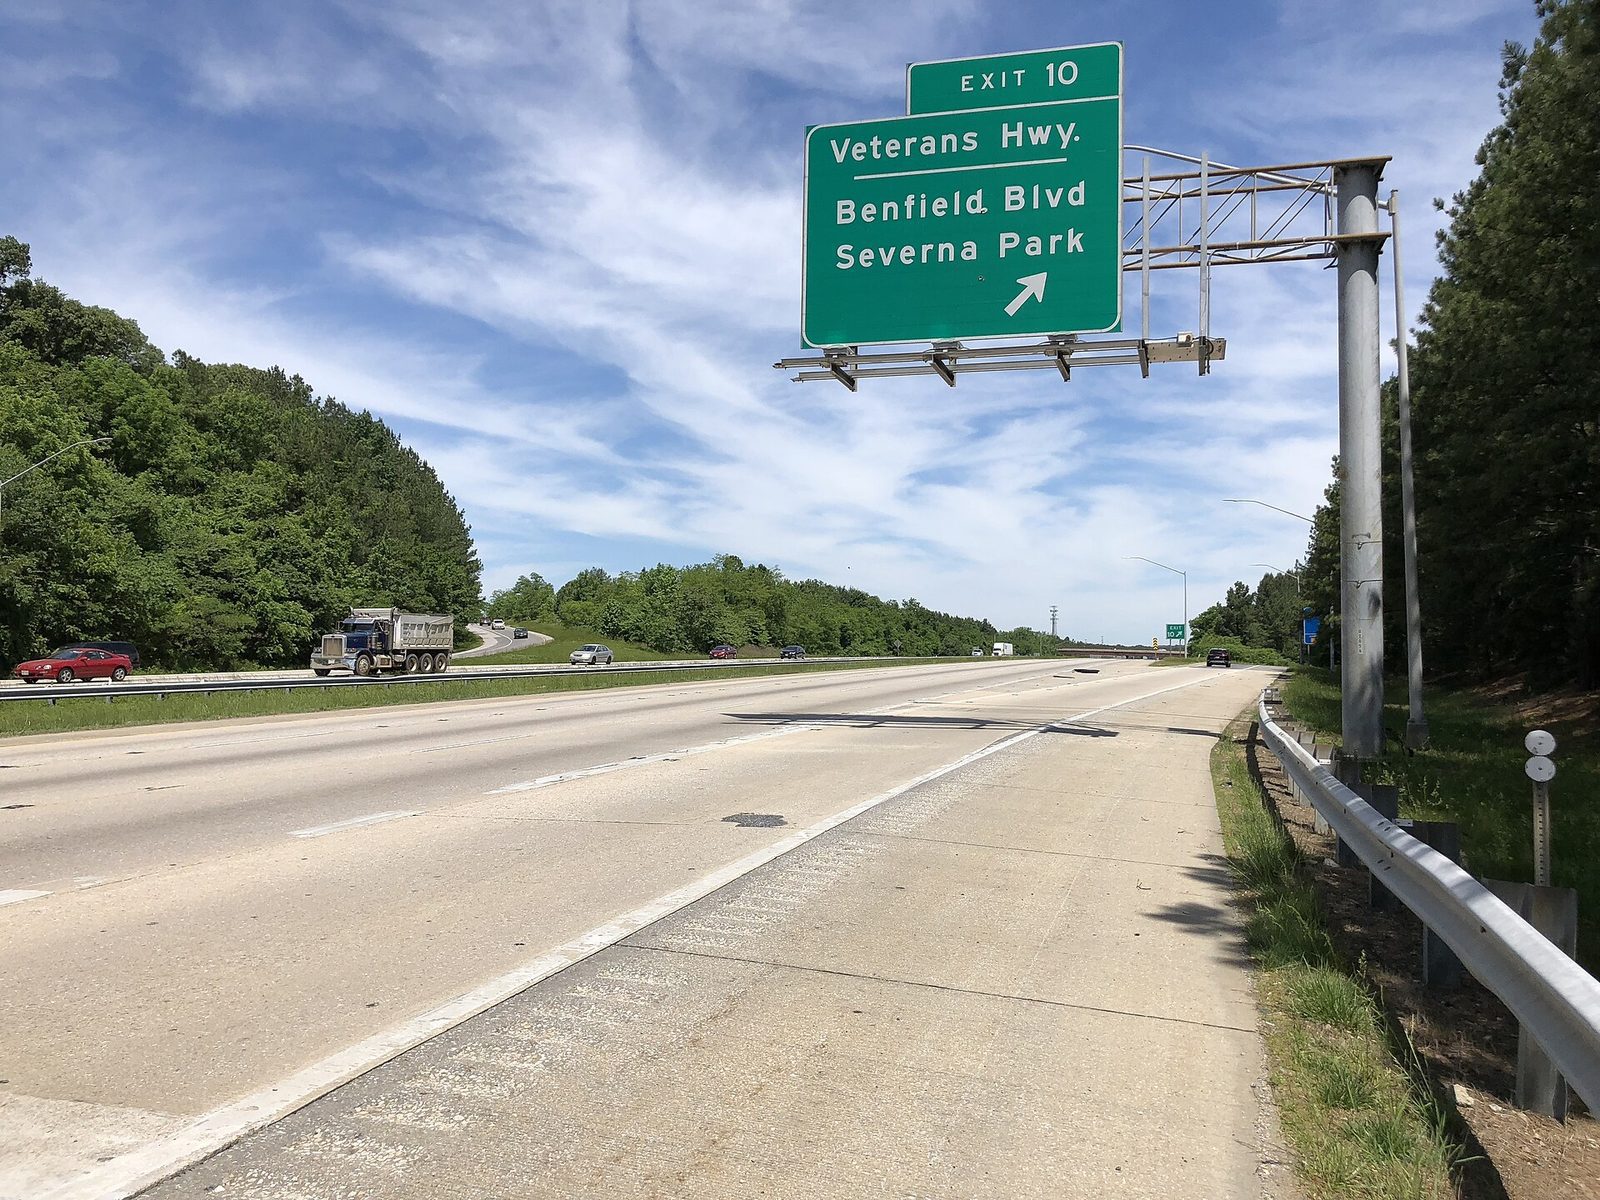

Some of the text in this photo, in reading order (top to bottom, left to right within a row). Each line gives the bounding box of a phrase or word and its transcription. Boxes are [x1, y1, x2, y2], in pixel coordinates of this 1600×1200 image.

[961, 61, 1079, 92] EXIT 10
[830, 121, 1080, 164] Veterans Hwy.
[836, 180, 1086, 225] Benfield Blvd
[836, 228, 1085, 270] Severna Park
